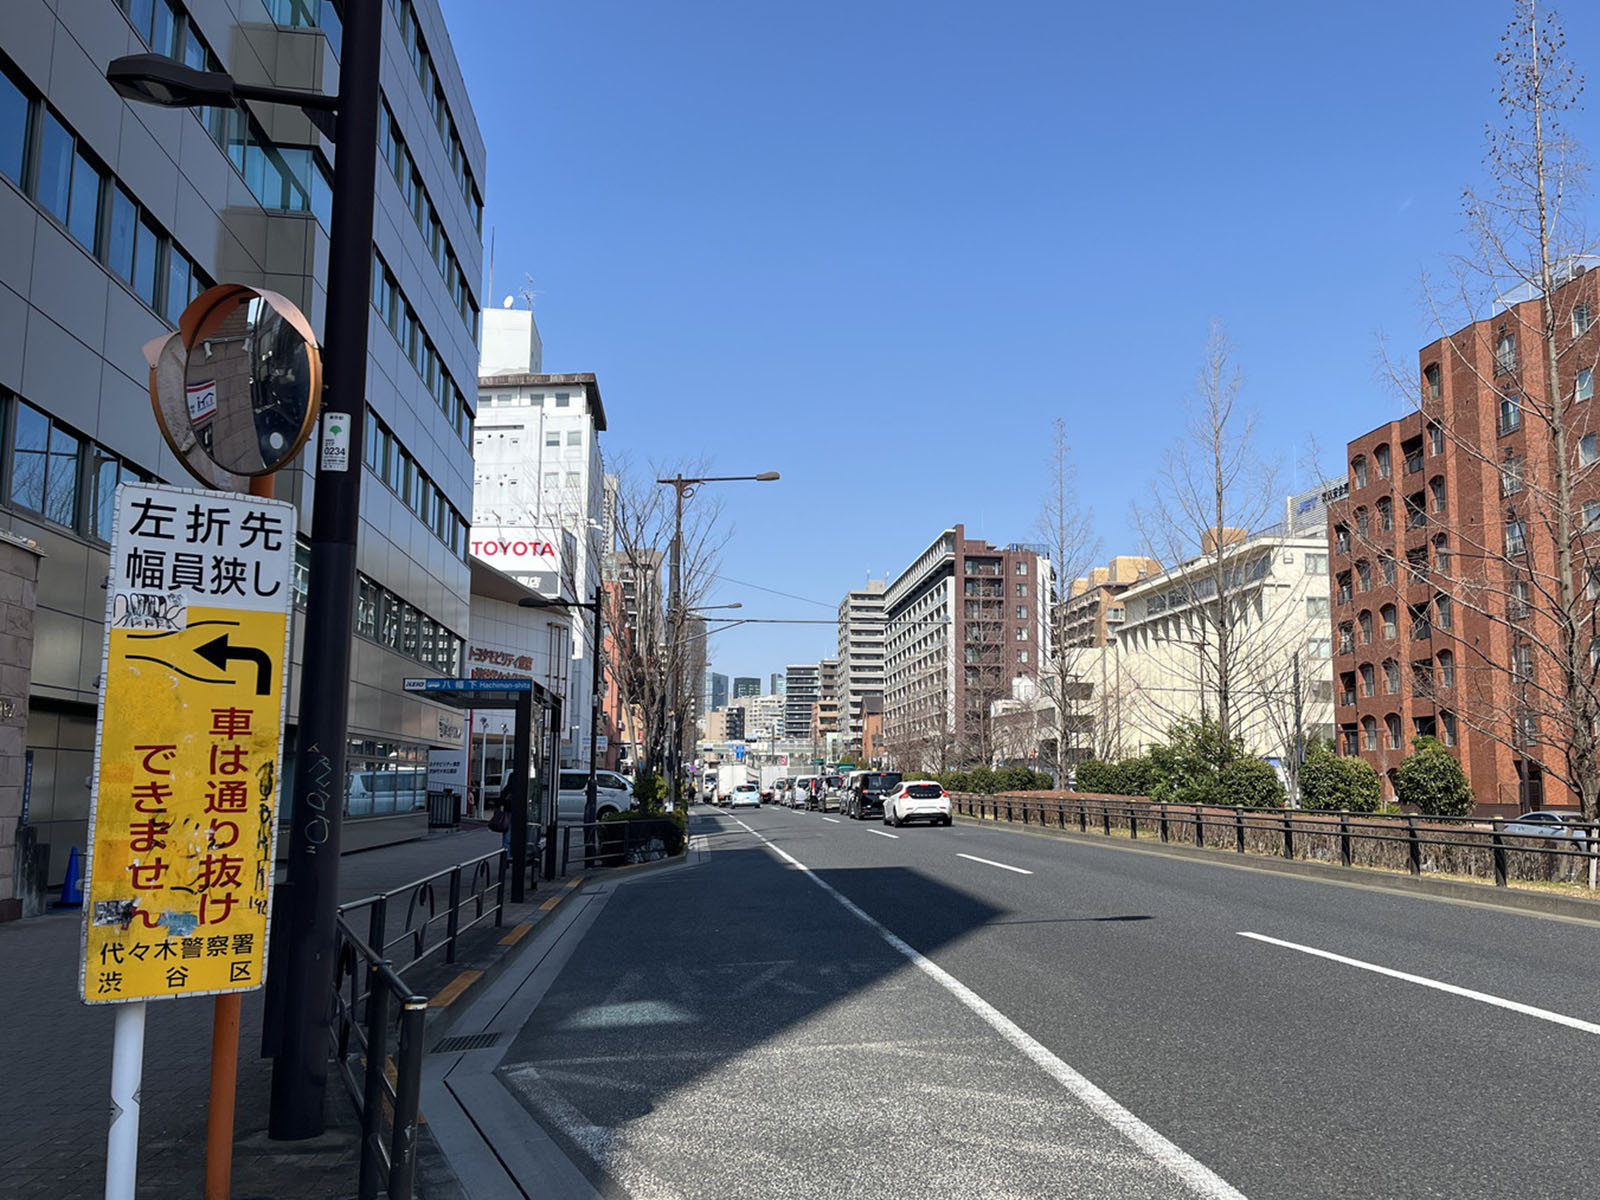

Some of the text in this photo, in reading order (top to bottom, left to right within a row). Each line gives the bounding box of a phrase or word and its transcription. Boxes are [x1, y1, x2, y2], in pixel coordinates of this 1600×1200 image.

[324, 447, 345, 456] 0234
[129, 497, 283, 551] 左折先
[471, 541, 555, 556] TOYOTA
[125, 547, 281, 597] 幅員狭し
[199, 707, 254, 925] 車は通り抜け
[121, 744, 177, 931] できません
[100, 933, 254, 965] 代々木警察署
[98, 961, 252, 993] 渋谷区
